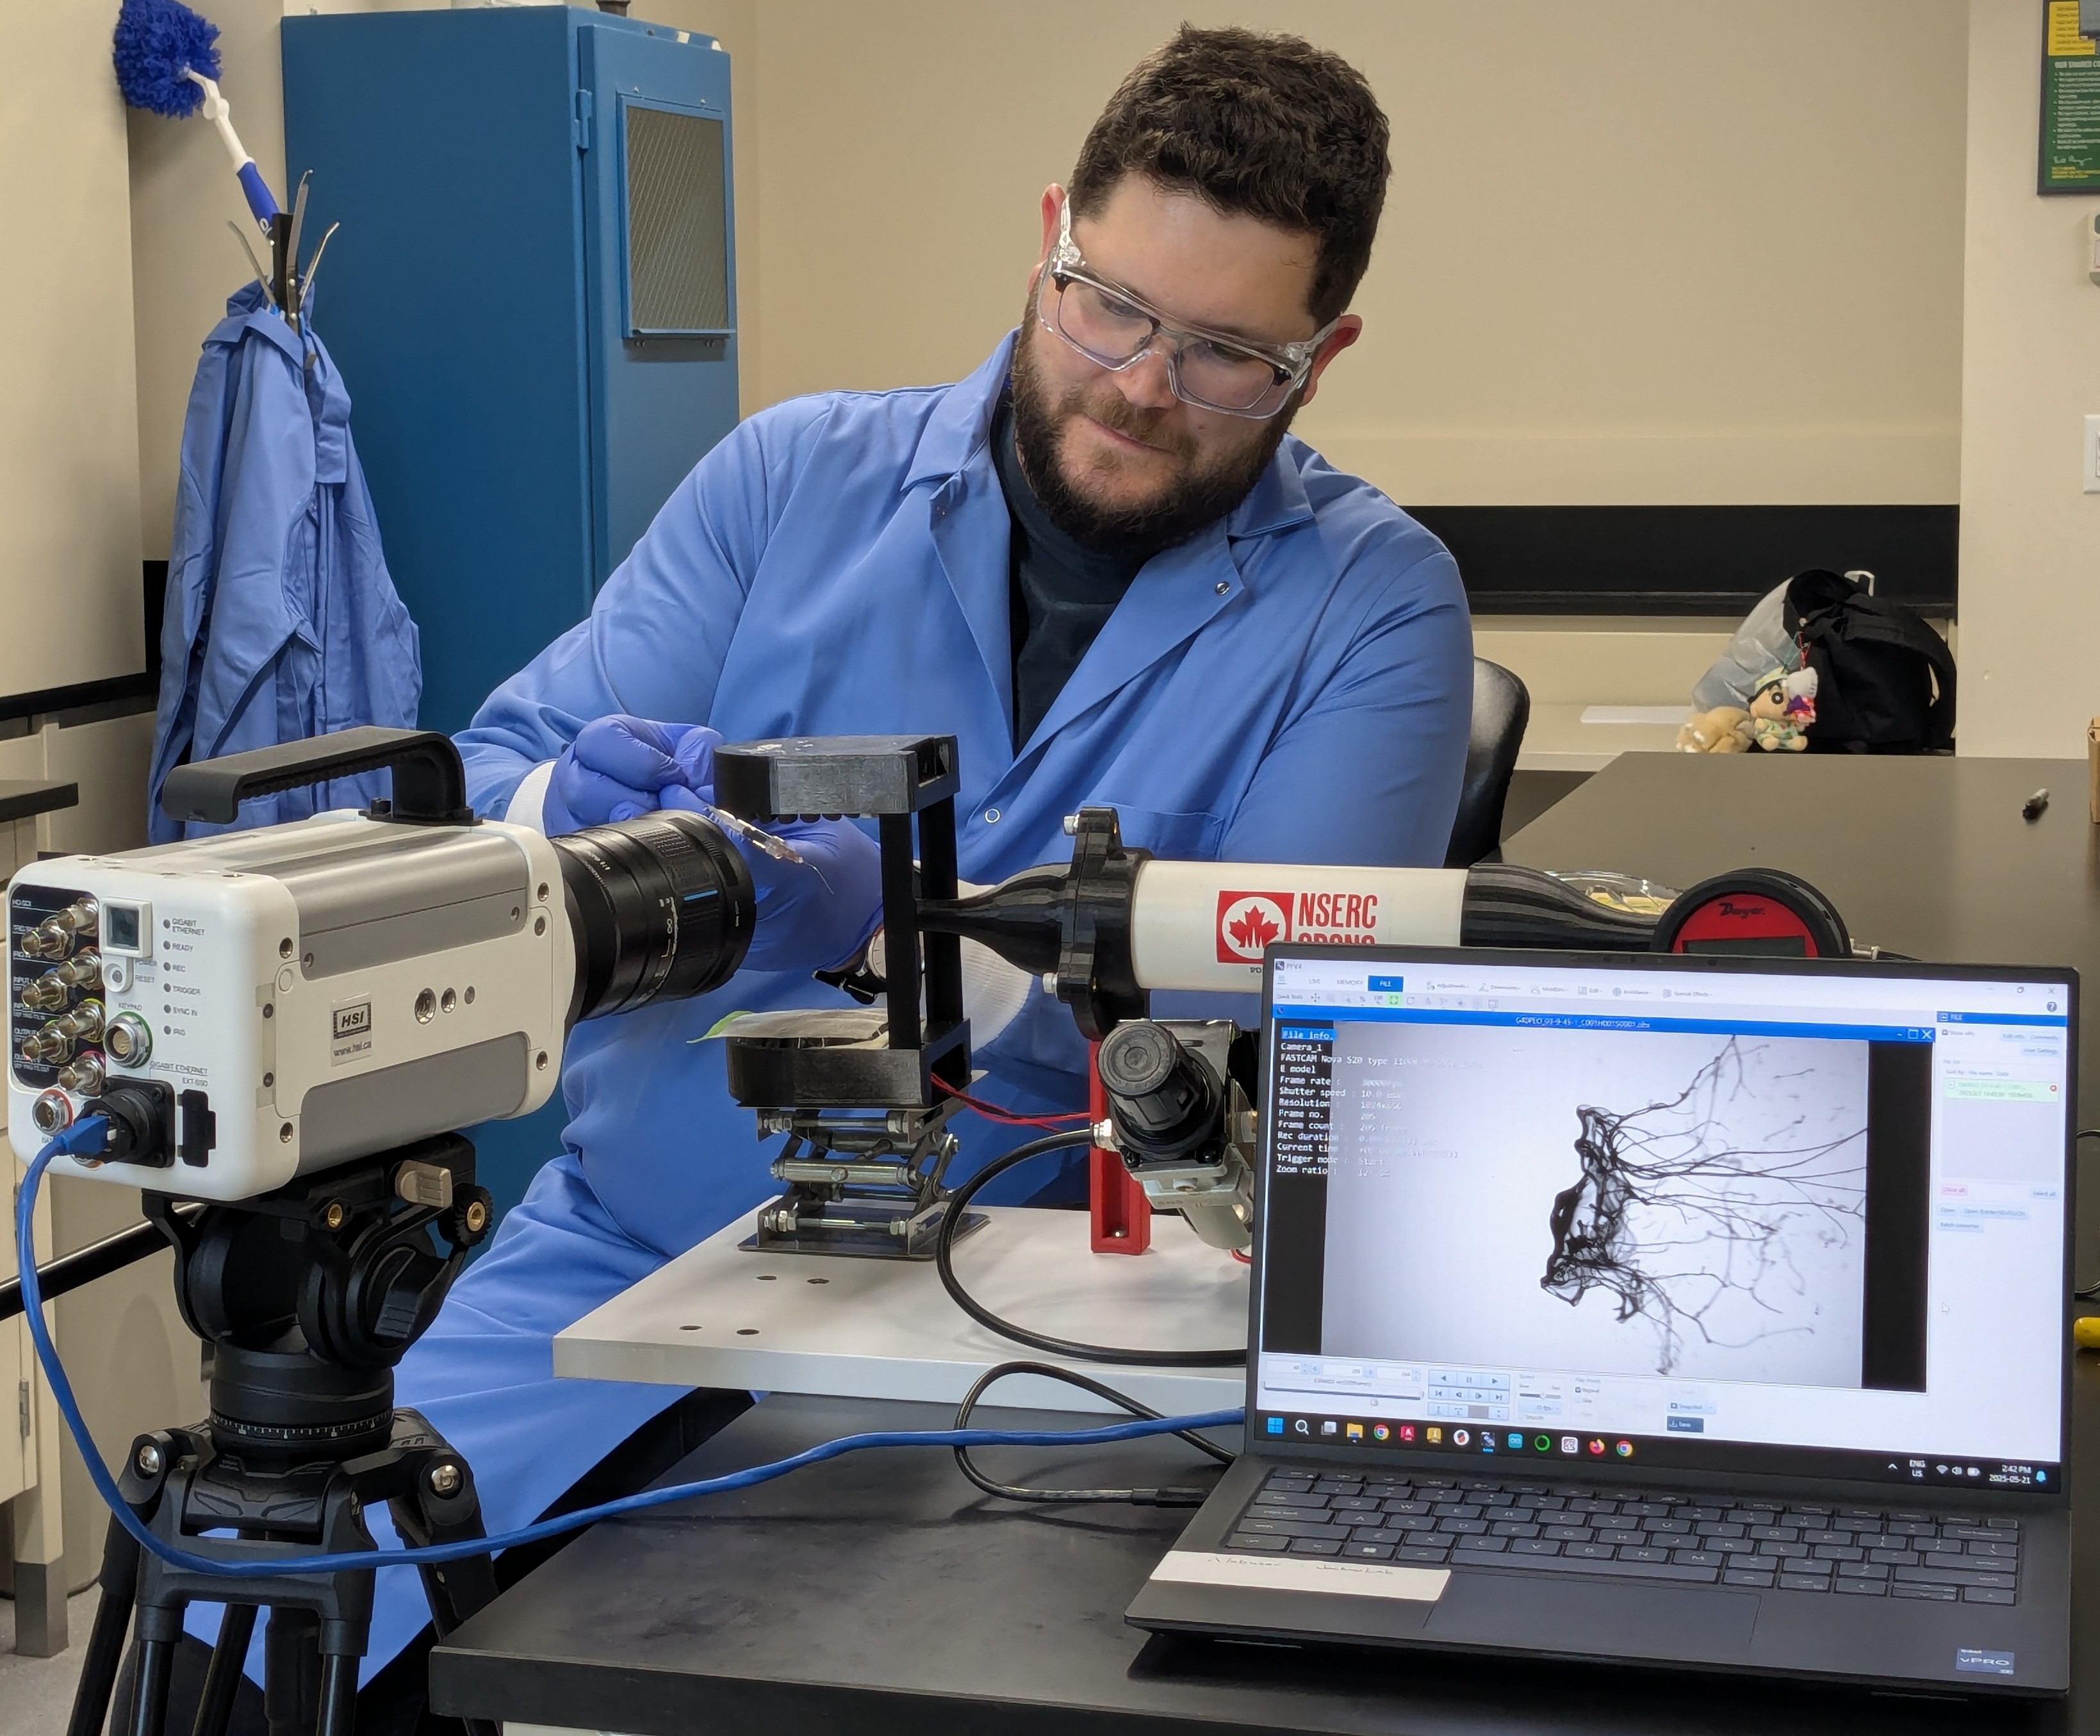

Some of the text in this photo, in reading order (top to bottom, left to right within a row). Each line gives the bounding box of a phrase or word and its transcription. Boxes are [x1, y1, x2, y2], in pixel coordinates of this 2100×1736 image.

[1298, 892, 1377, 929] NSERC
[173, 985, 201, 995] TRIGGER
[341, 1011, 365, 1028] HSI
[1283, 1030, 1304, 1038] File
[1281, 1042, 1323, 1054] Camera_1
[1281, 1054, 1317, 1062] FASTCAM
[1321, 1055, 1342, 1063] Nova
[1290, 1065, 1316, 1074] model
[1280, 1076, 1331, 1086] Frame rate
[1279, 1086, 1316, 1096] Shutter
[1320, 1088, 1346, 1098] speed
[1279, 1098, 1330, 1108] Resolution
[1279, 1109, 1304, 1118] Frame
[1278, 1120, 1304, 1129] Frame
[1309, 1122, 1333, 1130] count
[1277, 1131, 1339, 1141] Rec duration
[1277, 1142, 1313, 1152] Current
[1277, 1154, 1313, 1164] Trigger
[1276, 1165, 1328, 1175] Zoom ratio
[1912, 1469, 1923, 1478] US
